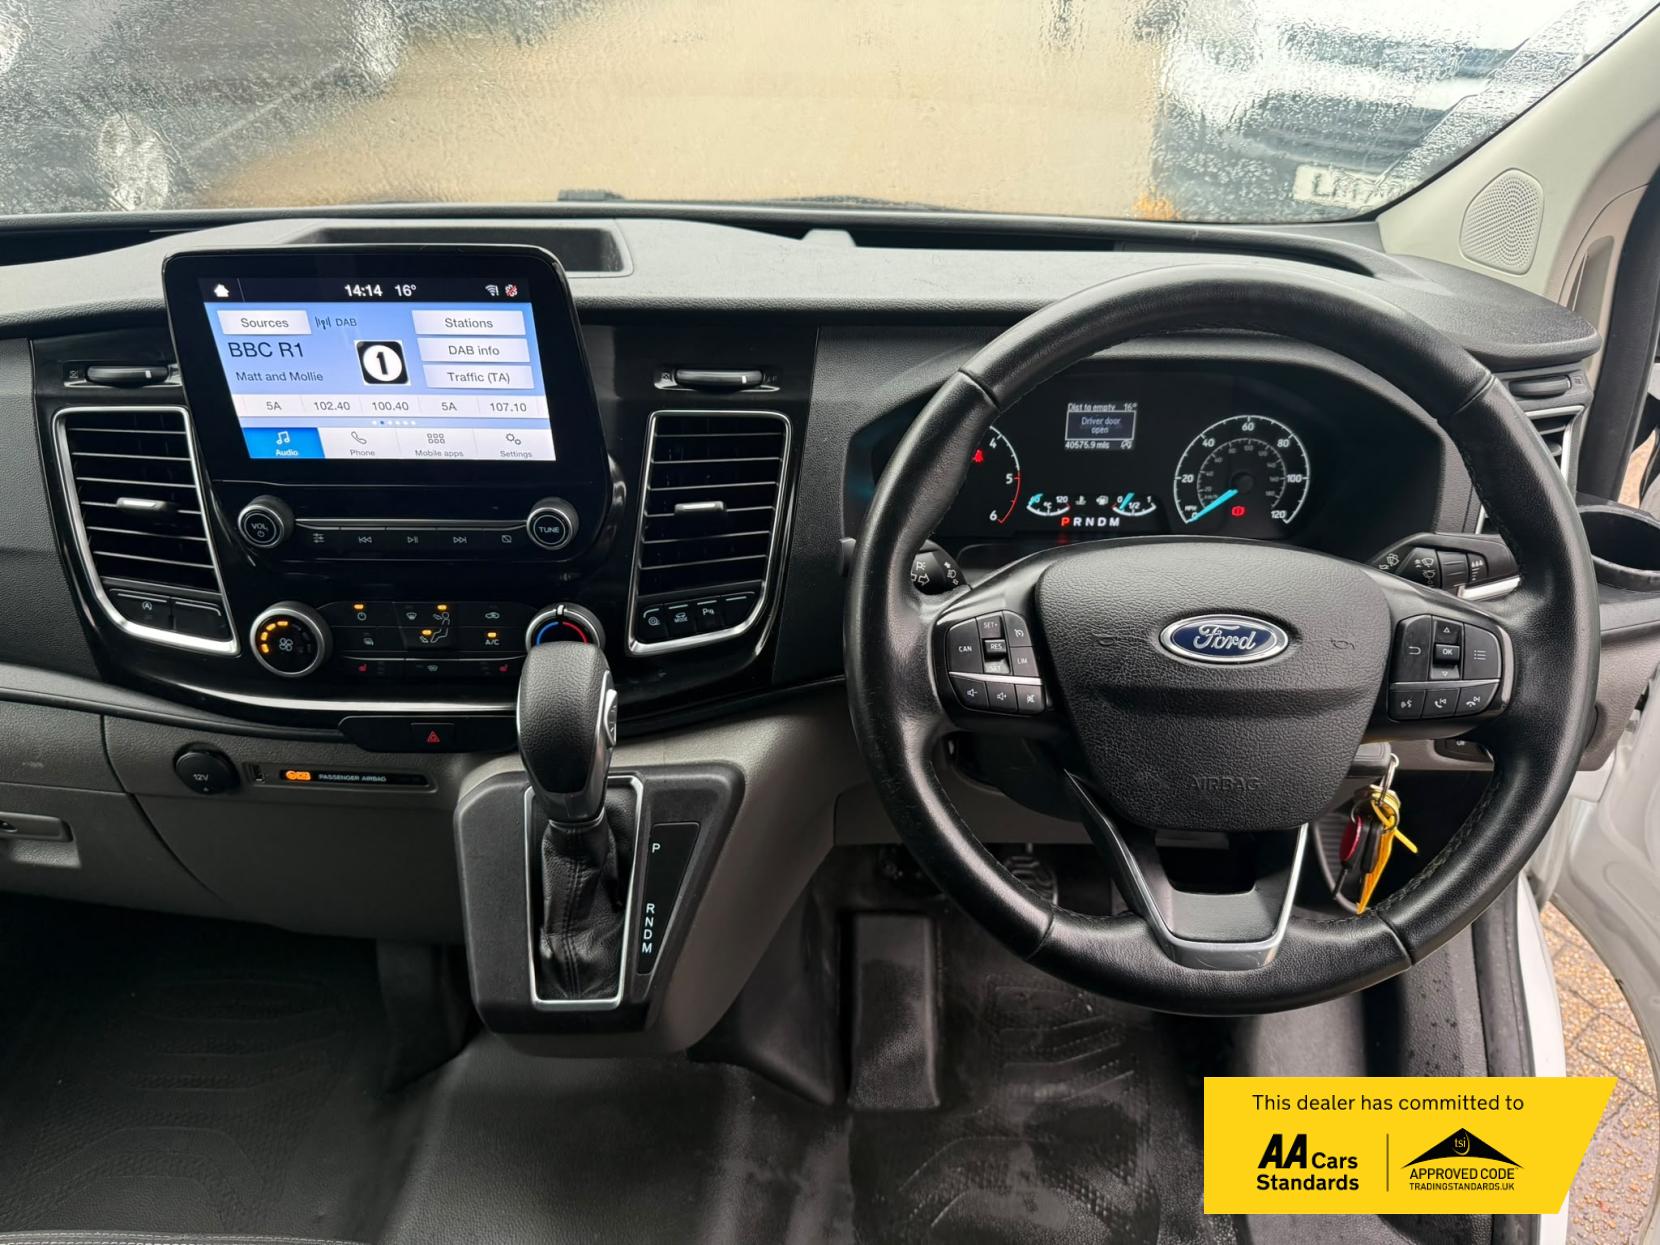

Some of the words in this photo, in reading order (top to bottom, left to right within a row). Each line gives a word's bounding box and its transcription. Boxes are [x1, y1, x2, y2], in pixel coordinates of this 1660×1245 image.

[344, 284, 383, 297] 14:14
[394, 284, 417, 297] 16°
[240, 317, 289, 328] Sources
[336, 317, 357, 327] DAB
[444, 317, 493, 328] Stations
[228, 341, 273, 358] BBC
[279, 341, 304, 358] R1
[448, 345, 475, 356] DAB
[478, 345, 500, 356] info
[376, 351, 389, 375] 1
[236, 371, 262, 382] Matt
[265, 371, 287, 382] and
[289, 371, 324, 382] Mollie
[447, 371, 484, 382] Traffic
[487, 372, 511, 384] (TA)
[266, 401, 282, 411] 5A
[313, 401, 351, 411] 102.40
[372, 401, 409, 411] 100.40
[441, 402, 458, 411] 5A
[489, 402, 527, 412] 107.10
[1092, 404, 1116, 412] empty
[1081, 416, 1104, 425] Driver
[1104, 416, 1121, 425] door
[1091, 427, 1109, 435] open
[1241, 422, 1255, 431] 60
[989, 438, 997, 448] 4
[1202, 438, 1215, 447] 40
[1277, 438, 1290, 447] 80
[275, 449, 299, 457] Audio
[415, 449, 442, 457] Mobile
[444, 450, 464, 458] apps
[500, 450, 533, 458] Settings
[1005, 473, 1014, 484] 5
[1181, 474, 1194, 483] 20
[1286, 474, 1302, 483] 100
[989, 510, 998, 521] 6
[1271, 510, 1287, 519] 120
[251, 522, 269, 531] VOL
[1061, 517, 1070, 526] P
[1073, 517, 1082, 526] R
[1085, 517, 1094, 526] N
[1097, 517, 1106, 526] D
[1109, 517, 1120, 526] M
[1193, 624, 1257, 650] Ford
[1442, 648, 1453, 656] OK
[193, 773, 209, 782] 12V
[318, 774, 360, 782] PASSENGER
[1191, 775, 1261, 791] AIRBAG
[652, 843, 661, 853] P
[646, 903, 655, 914] R
[644, 917, 654, 927] N
[643, 929, 653, 940] D
[641, 942, 653, 953] M
